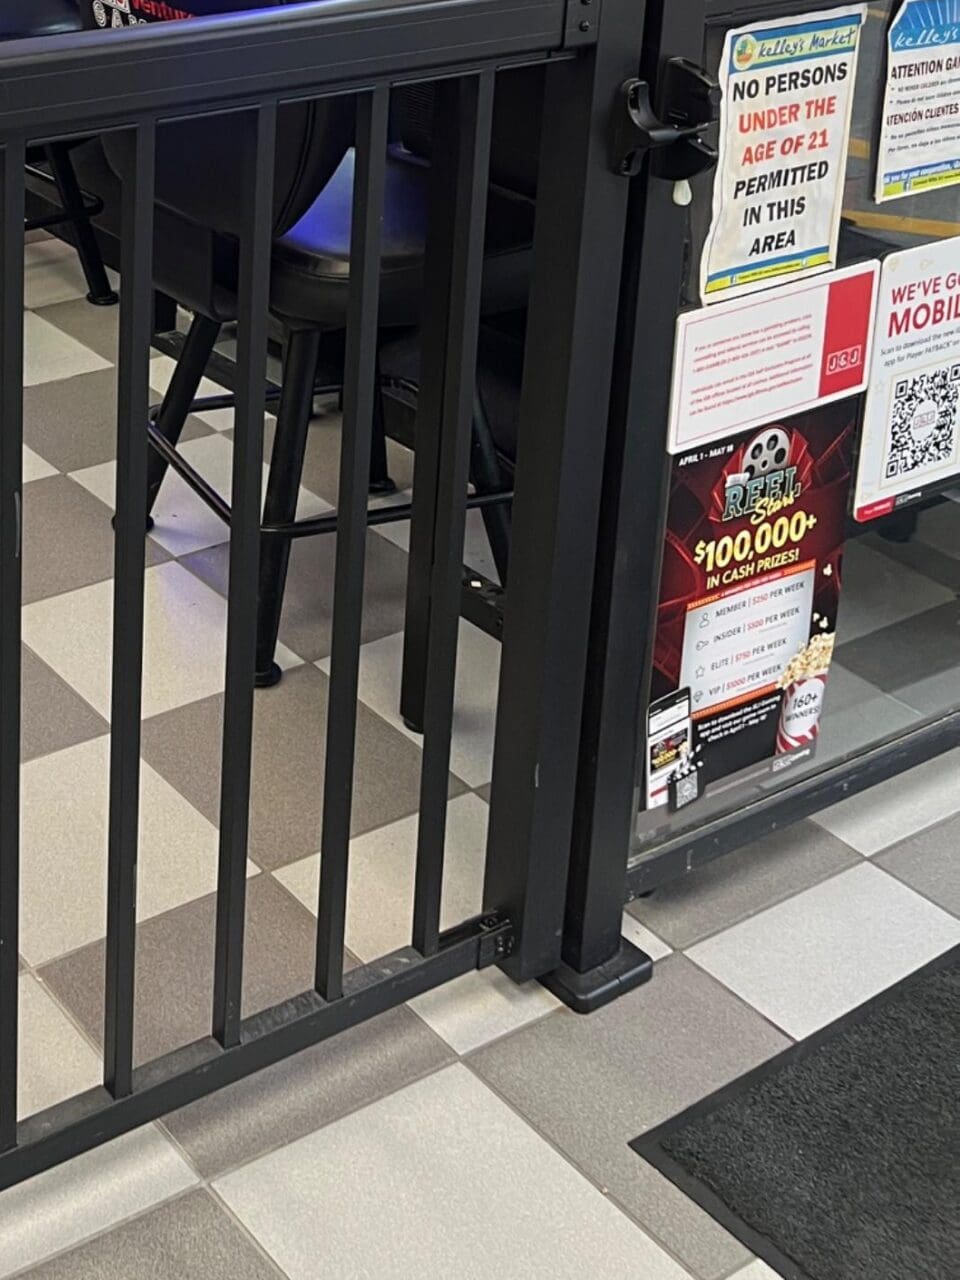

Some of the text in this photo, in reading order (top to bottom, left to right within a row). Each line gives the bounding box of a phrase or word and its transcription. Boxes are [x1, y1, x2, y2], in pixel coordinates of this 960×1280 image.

[809, 27, 856, 51] Market
[732, 62, 848, 102] NO PERSONS
[891, 56, 960, 80] ATTENTION GA
[739, 95, 837, 134] UNDER THE
[925, 103, 959, 120] CLIENTES
[741, 128, 829, 166] AGE OF 21
[733, 160, 830, 200] PERMITTED
[743, 196, 806, 227] IN THIS
[748, 229, 796, 257] AREA
[891, 273, 960, 305] WE'VE G
[679, 455, 699, 467] APRIL
[709, 447, 726, 458] MAY
[722, 466, 801, 522] REEL
[750, 492, 795, 525] Stars
[693, 511, 817, 572] $100,000+
[706, 575, 720, 590] IN
[722, 563, 755, 584] CASH
[756, 548, 800, 573] PRIZES!
[715, 600, 746, 618] MEMBER
[769, 588, 783, 598] PER
[784, 581, 805, 594] WEEK
[713, 626, 741, 642] INSIDER
[764, 613, 778, 624] PER
[780, 607, 800, 619] WEEK
[710, 658, 729, 671] ELITE
[752, 644, 765, 655] PER
[766, 638, 787, 650] WEEK
[708, 684, 721, 696] VIP
[747, 670, 760, 681] PER
[761, 663, 782, 676] WEEK
[793, 692, 818, 709] 160+
